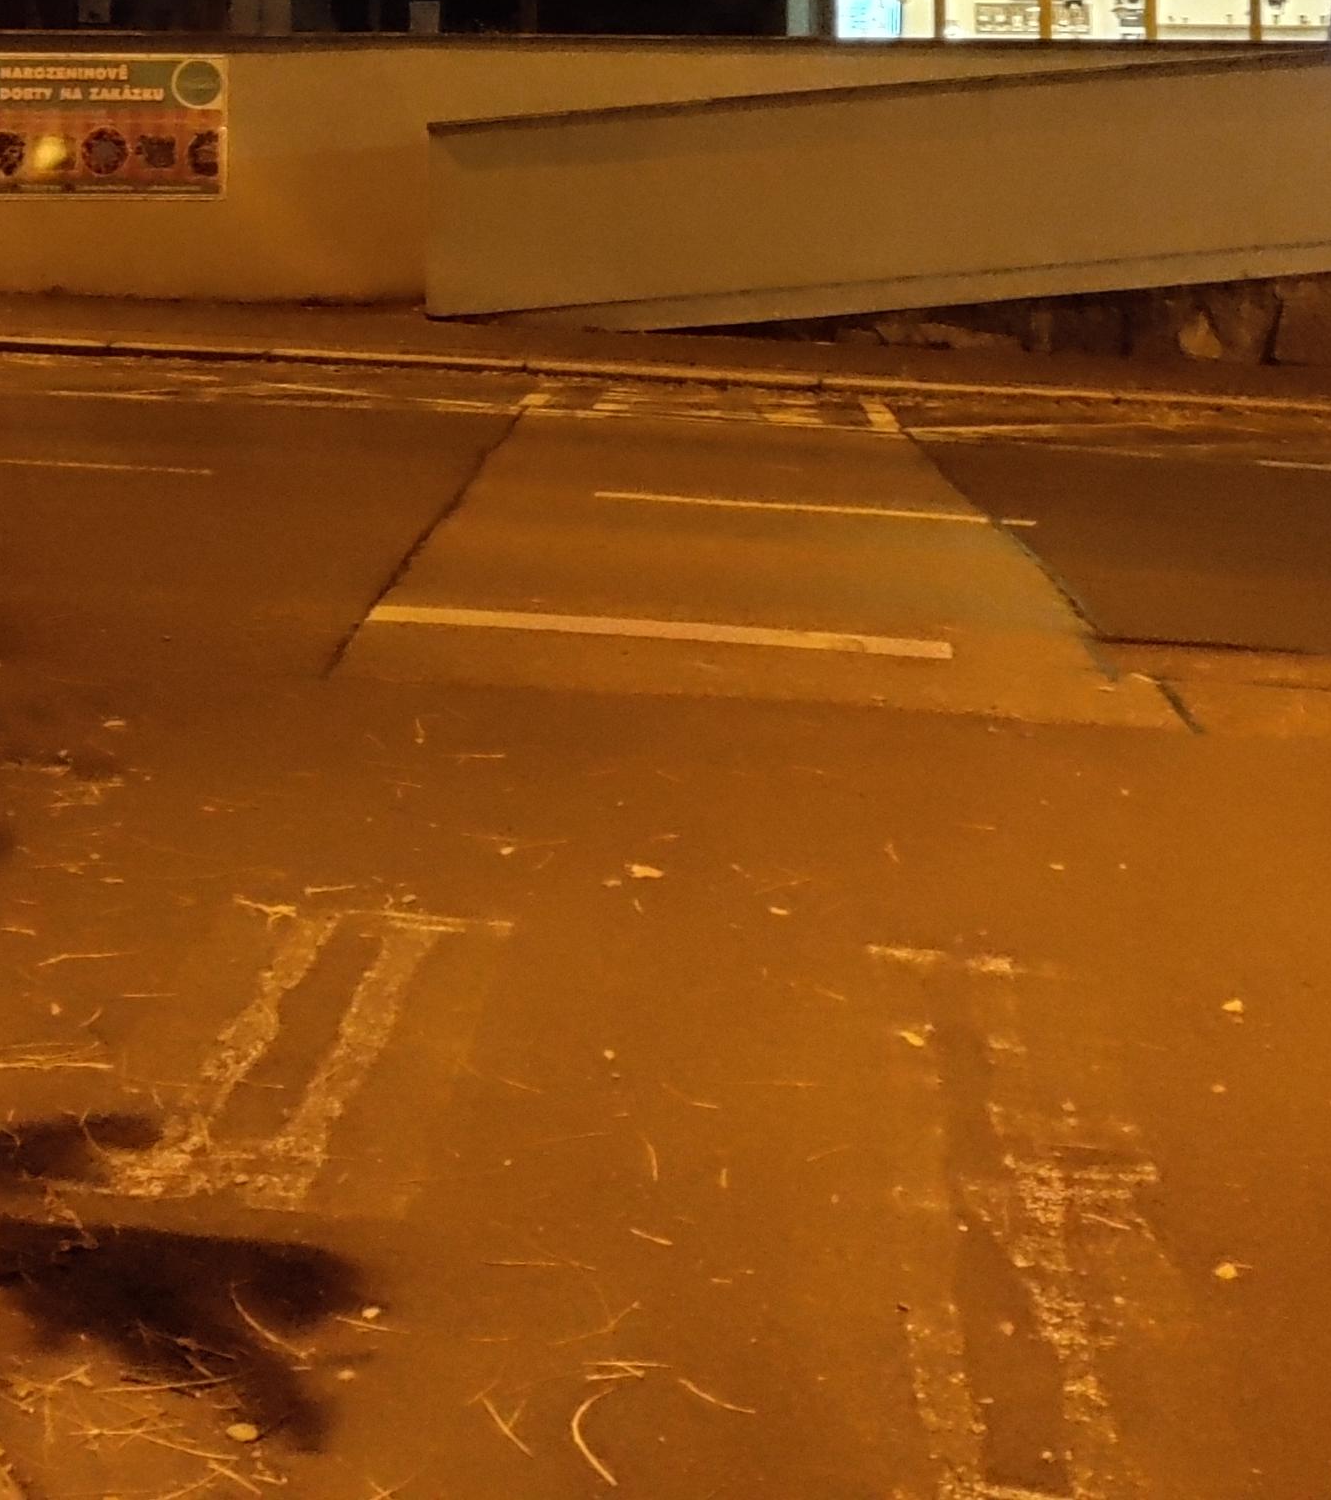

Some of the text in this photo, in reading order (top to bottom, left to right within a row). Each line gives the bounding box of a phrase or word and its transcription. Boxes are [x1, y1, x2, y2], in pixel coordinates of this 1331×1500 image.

[0, 64, 129, 80] NAROZENINOVÉ
[0, 84, 165, 101] DORTY NA ZAKÁZKU
